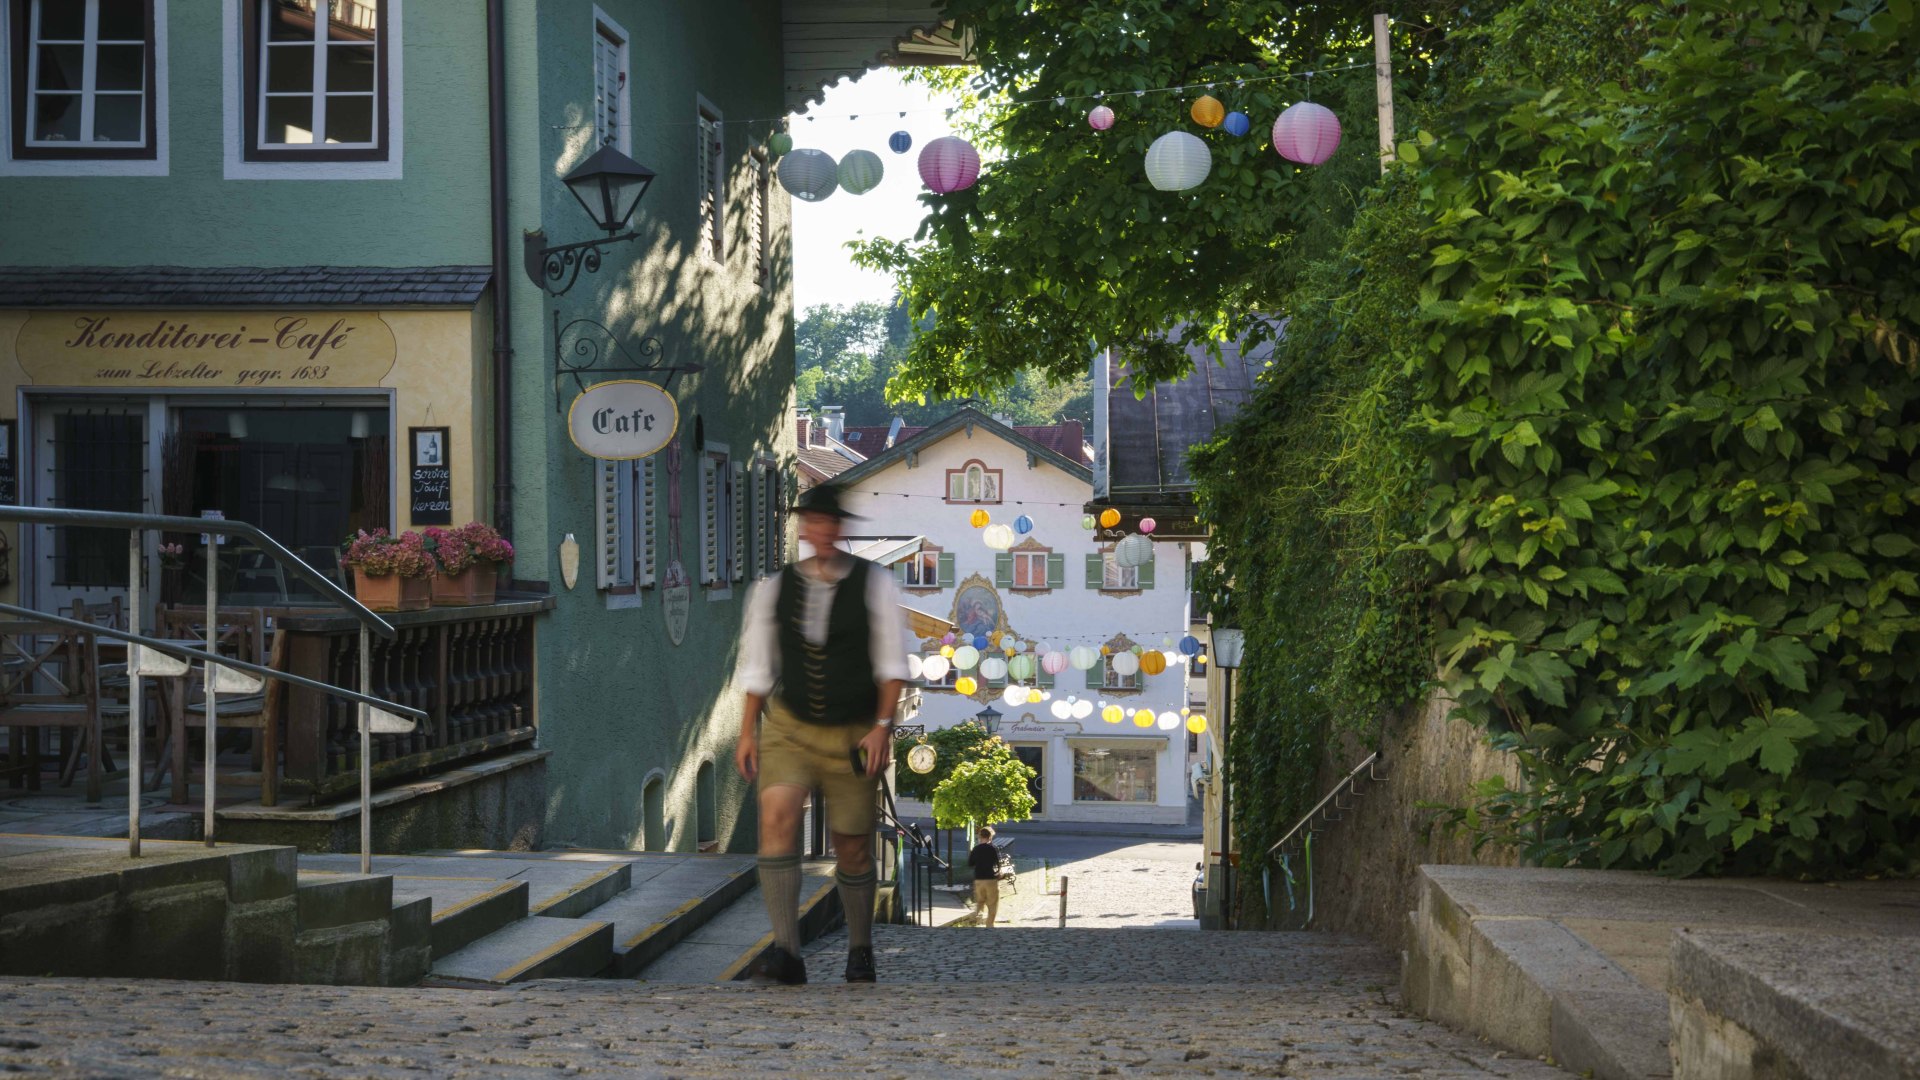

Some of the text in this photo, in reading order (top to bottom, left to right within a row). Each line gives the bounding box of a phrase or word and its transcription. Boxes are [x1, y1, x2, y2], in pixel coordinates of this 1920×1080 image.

[94, 360, 330, 385] zum Lebzelter gegr. 1683
[592, 407, 655, 438] Cafe
